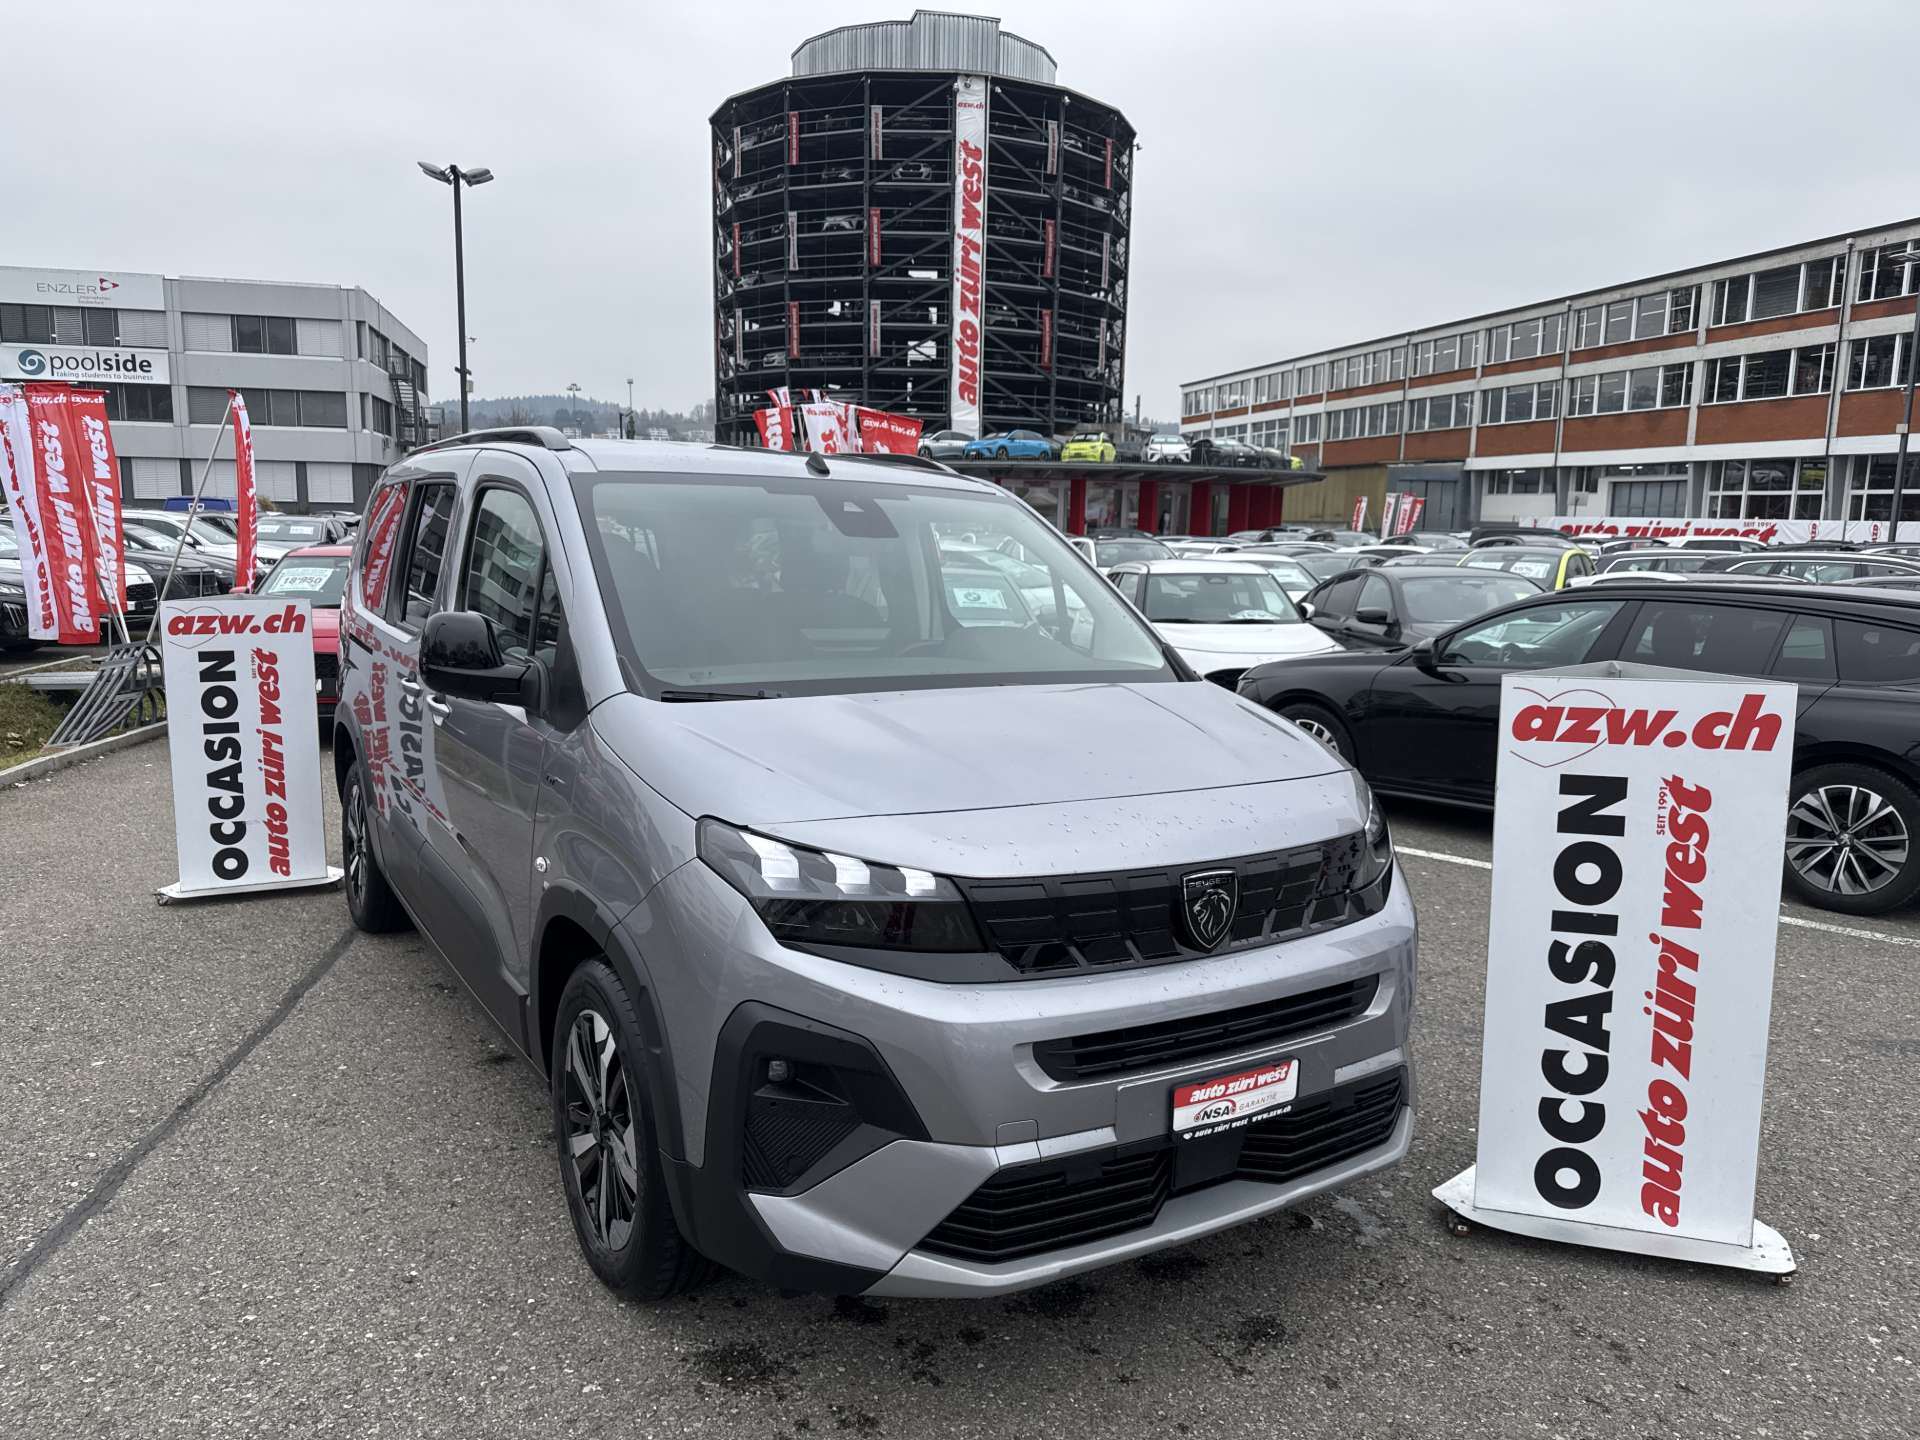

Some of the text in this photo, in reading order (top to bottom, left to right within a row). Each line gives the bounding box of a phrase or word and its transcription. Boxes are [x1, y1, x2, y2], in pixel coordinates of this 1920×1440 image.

[957, 101, 985, 110] azw.ch
[36, 281, 98, 295] ENZLER
[955, 138, 983, 406] auto züri west
[49, 351, 153, 377] poolside
[55, 370, 154, 381] taking students to business
[80, 414, 112, 480] west
[38, 419, 95, 633] auto züri west
[167, 604, 306, 637] azw.ch
[1511, 694, 1783, 753] azw.ch
[197, 650, 249, 881] OCCASION
[253, 647, 292, 878] auto züri west
[1656, 786, 1668, 836] SEIT 1991
[1533, 773, 1629, 1210] OCCASION
[1636, 774, 1714, 1228] auto züri west
[1189, 1065, 1289, 1103] auto züri west
[1200, 1092, 1278, 1121] NSA GARANTIE
[1193, 1128, 1213, 1138] auto
[1231, 1118, 1249, 1128] west
